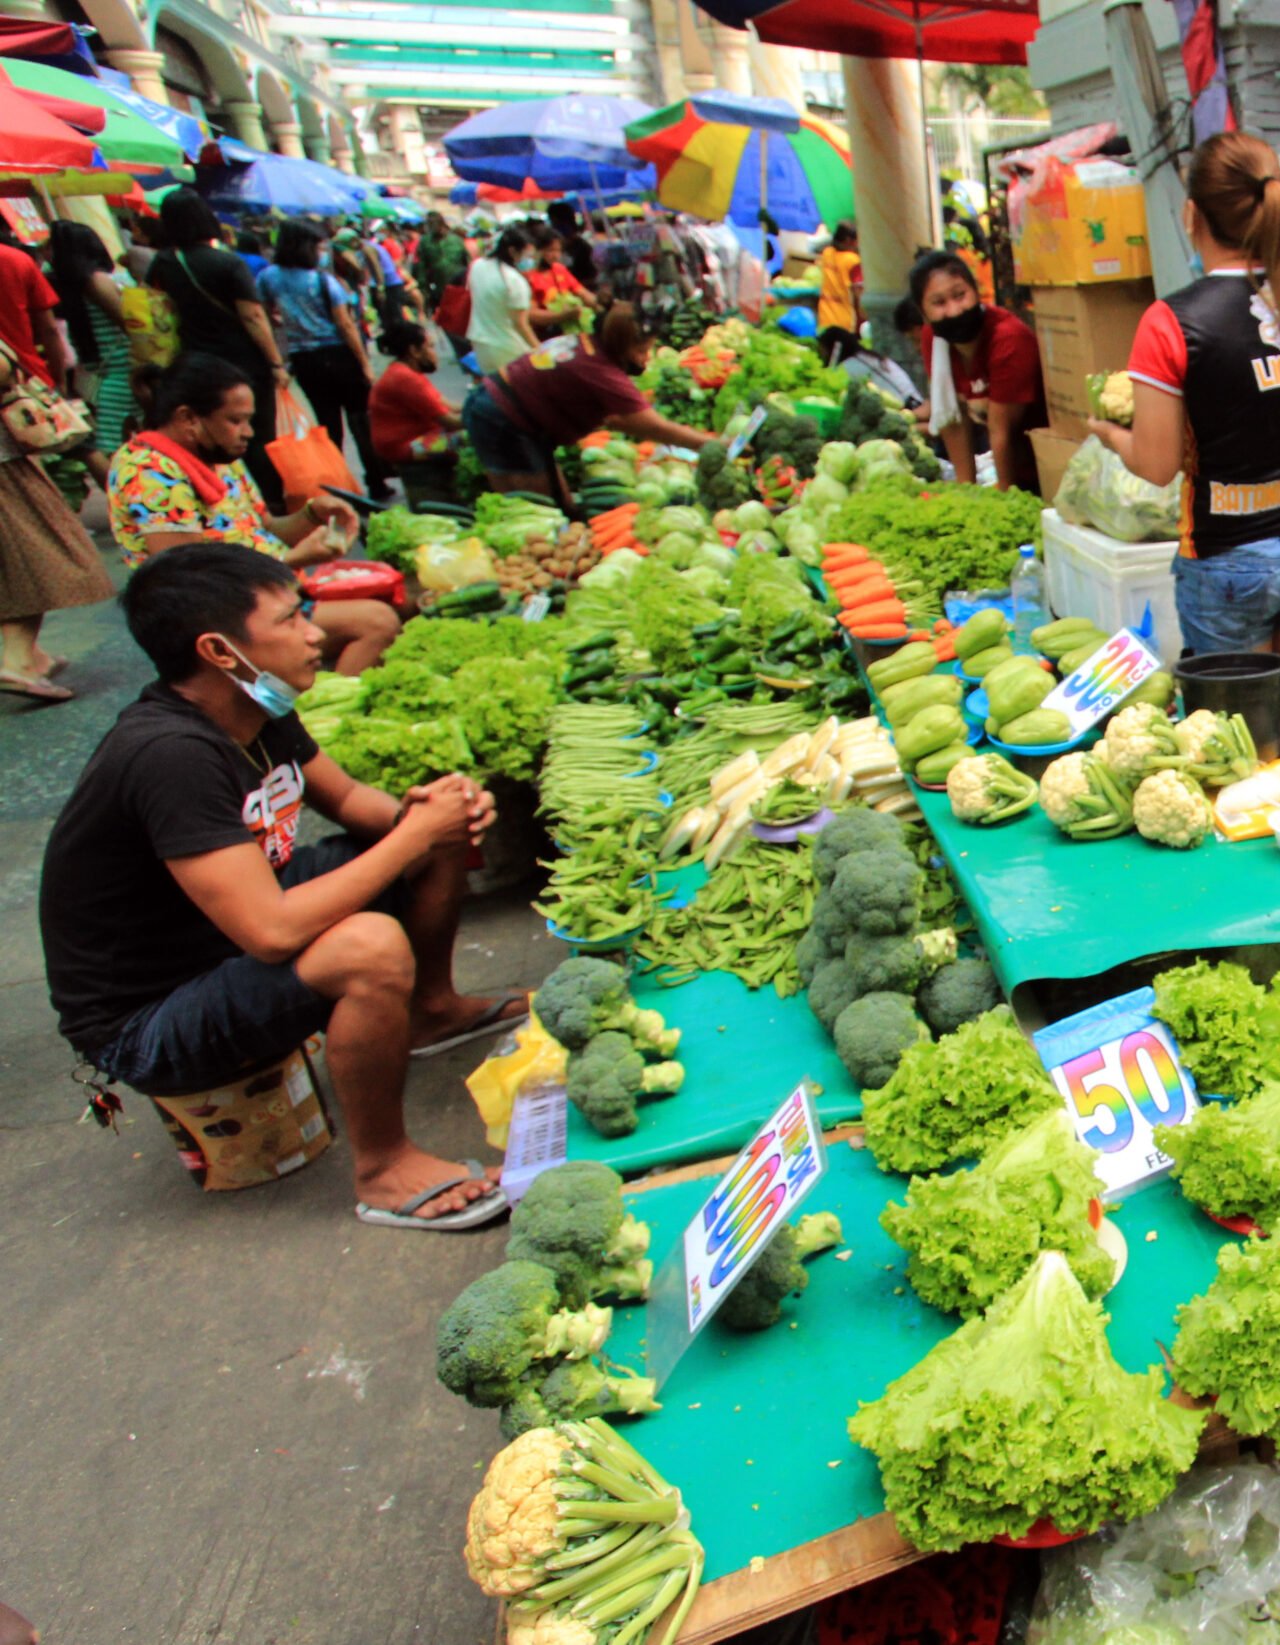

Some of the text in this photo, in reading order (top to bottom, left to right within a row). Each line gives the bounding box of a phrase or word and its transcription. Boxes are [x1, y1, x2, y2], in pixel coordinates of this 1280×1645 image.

[1063, 636, 1143, 711] 30
[1061, 1031, 1186, 1153] 50
[704, 1130, 786, 1288] 100
[1145, 1151, 1175, 1169] FE
